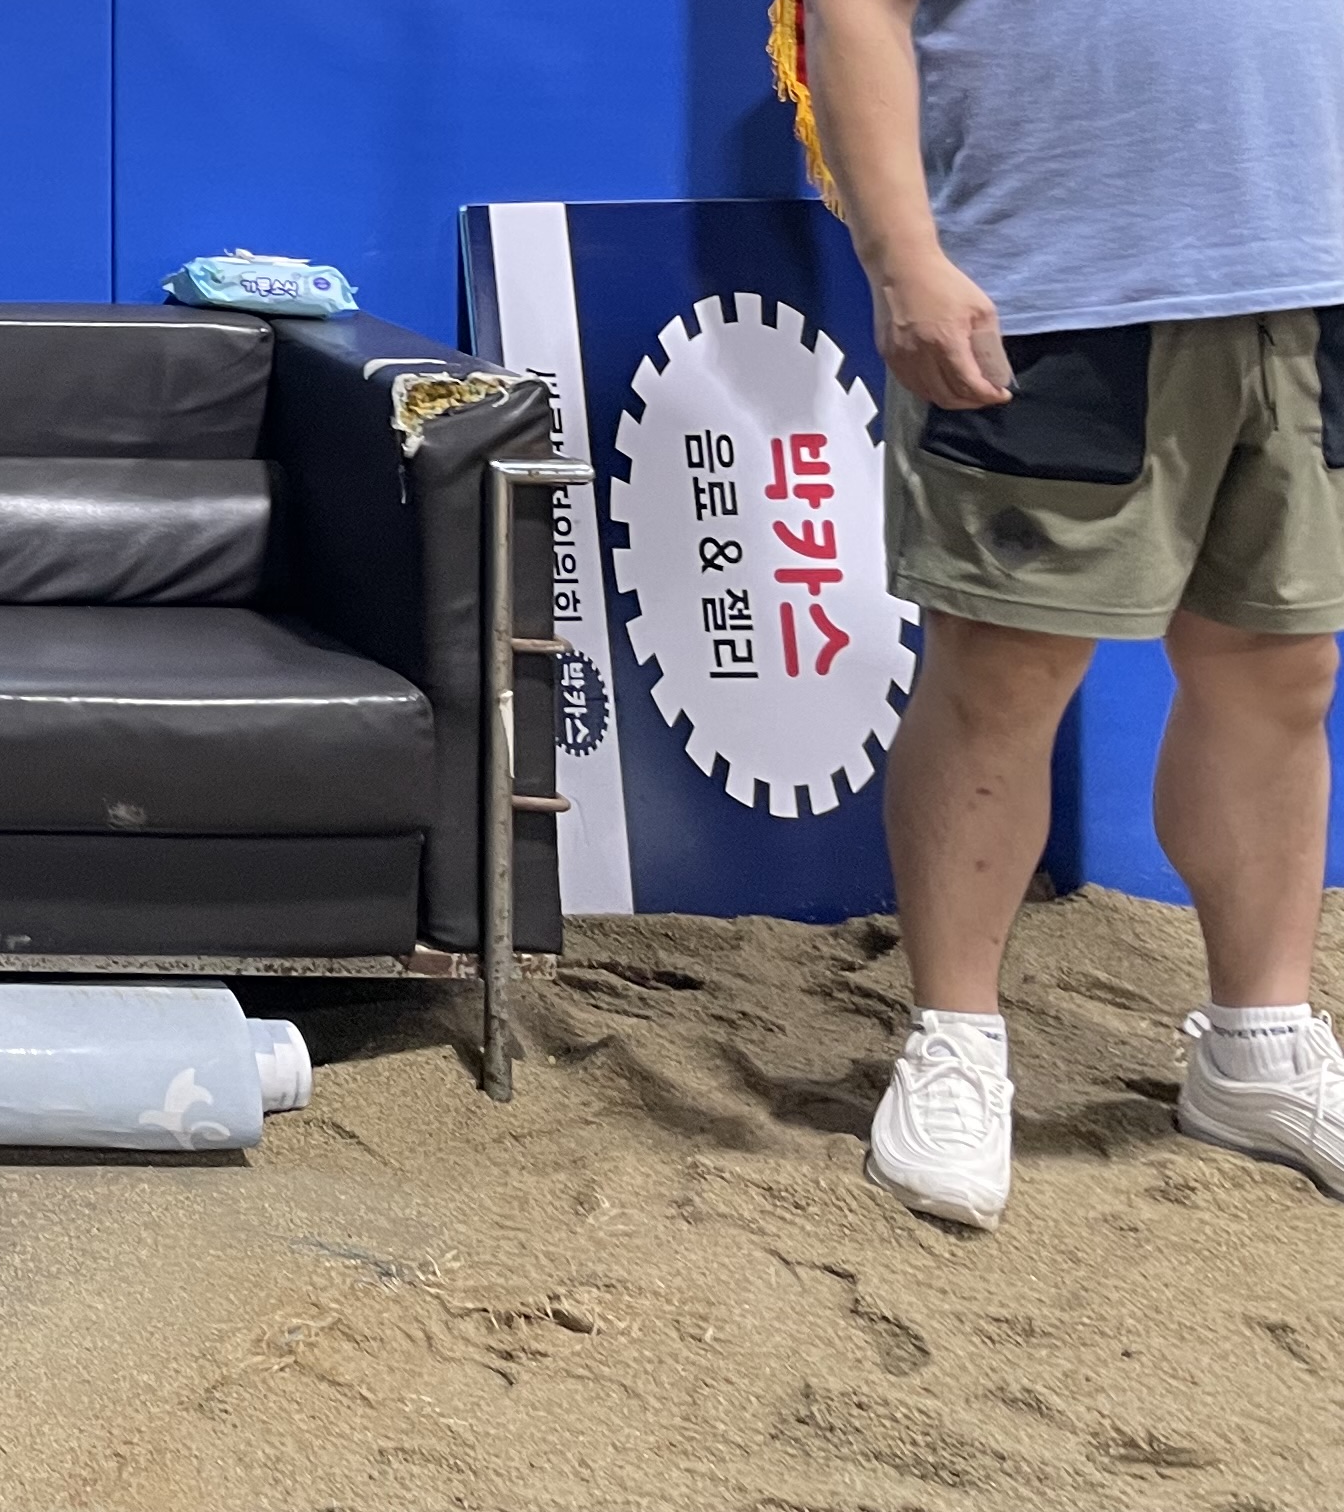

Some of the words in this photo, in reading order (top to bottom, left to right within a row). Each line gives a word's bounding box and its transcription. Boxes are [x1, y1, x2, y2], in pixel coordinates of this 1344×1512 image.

[684, 430, 738, 521] 음료
[698, 537, 743, 573] &
[765, 433, 849, 677] 박카스
[701, 588, 759, 678] 젤리
[561, 662, 589, 744] 박카스
